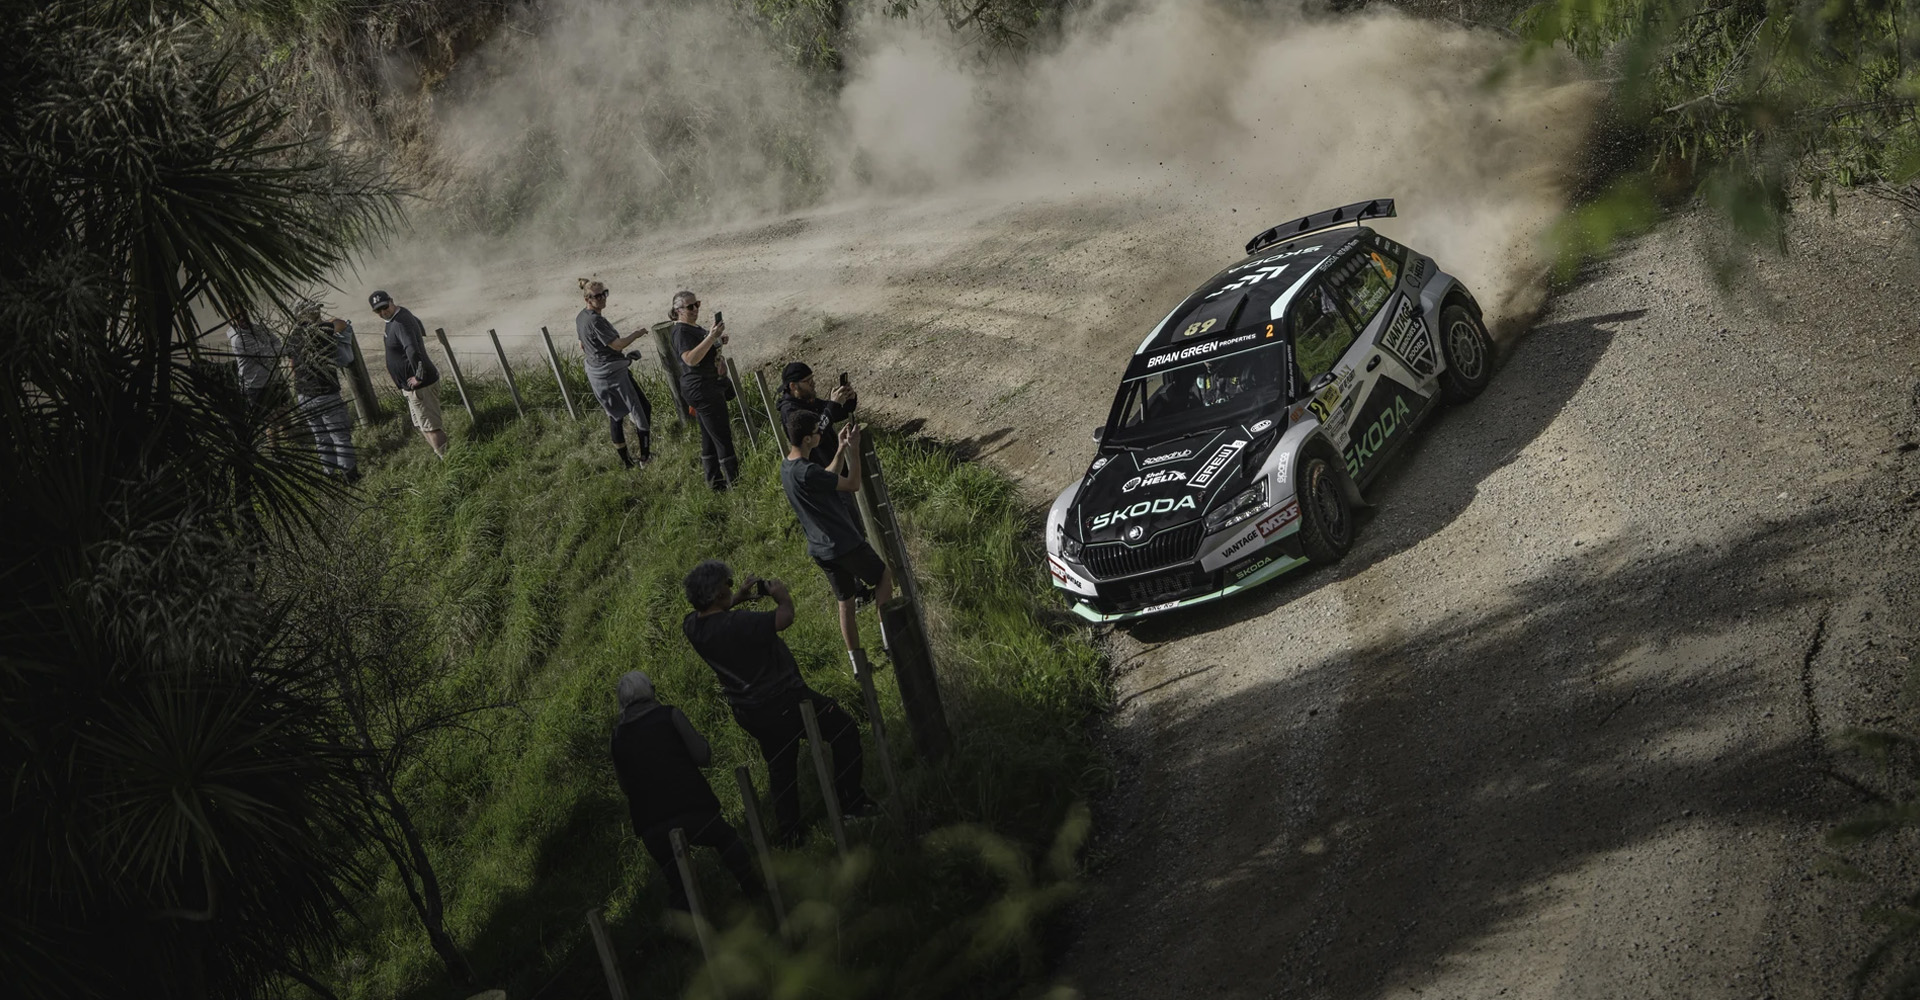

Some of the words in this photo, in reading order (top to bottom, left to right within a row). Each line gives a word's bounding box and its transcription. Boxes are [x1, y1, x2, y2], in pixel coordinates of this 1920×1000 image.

[1228, 244, 1323, 274] SKODA
[1371, 252, 1393, 278] 2
[1356, 285, 1370, 300] Hunt
[1184, 318, 1217, 336] 89
[1265, 324, 1274, 338] 2
[1386, 302, 1413, 348] VANTAGE
[1147, 350, 1180, 368] BRIAN
[1180, 341, 1218, 359] GREEN
[1218, 333, 1257, 347] PROPERTIES
[1399, 325, 1417, 354] WINDOWS
[1409, 338, 1425, 361] DOORS
[1310, 402, 1328, 421] 2
[1345, 394, 1410, 479] SKODA
[1142, 449, 1192, 466] Speedhub
[1196, 448, 1233, 483] BREW
[1277, 452, 1290, 483] sparco
[1141, 470, 1187, 487] HELIX
[1145, 469, 1166, 479] Shell
[1091, 495, 1196, 531] SKODA
[1261, 505, 1299, 535] MRF
[1222, 530, 1258, 558] VANTAGE
[1236, 556, 1272, 579] SKODA
